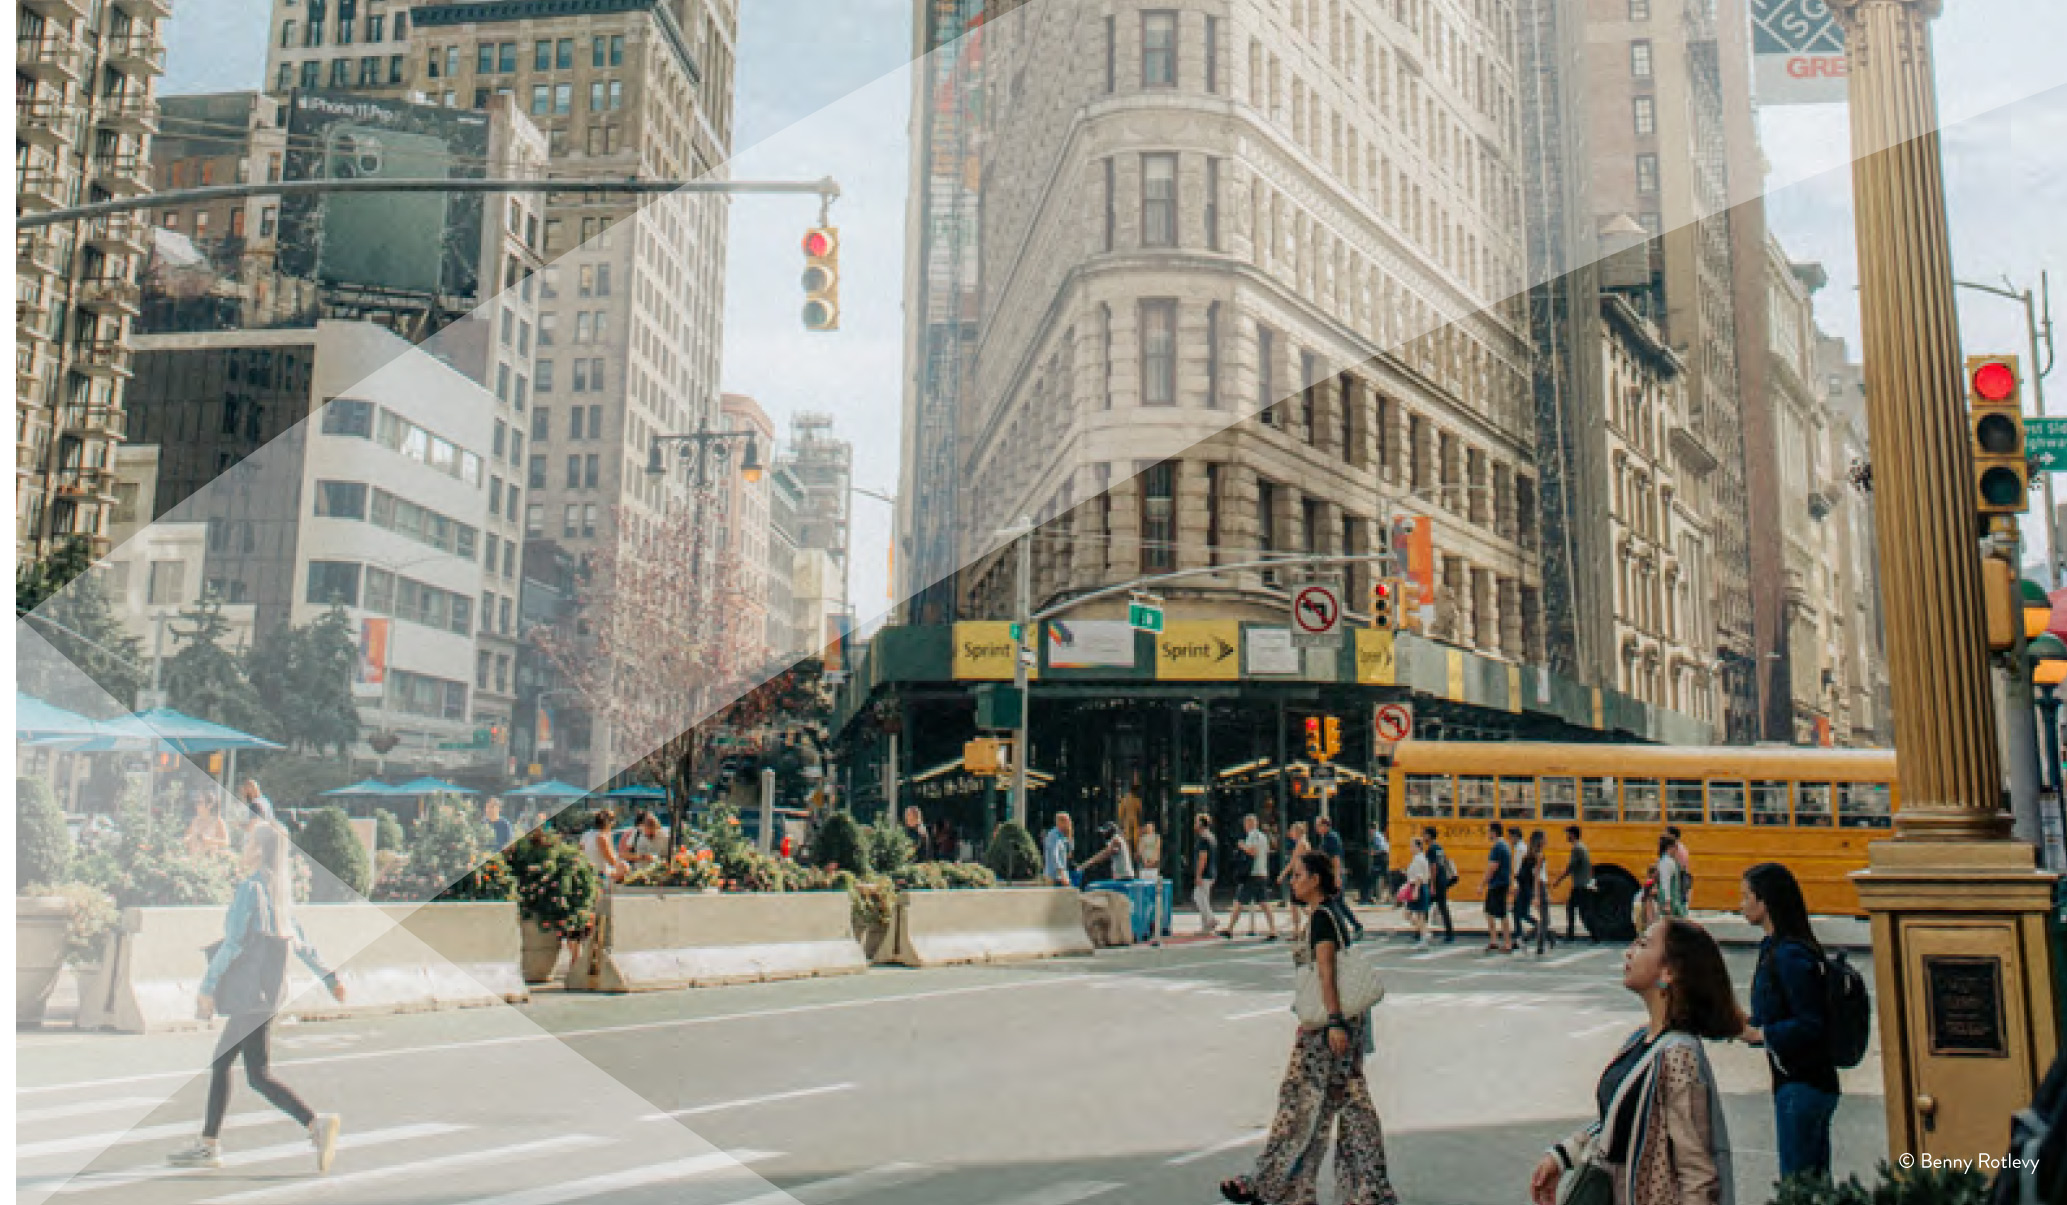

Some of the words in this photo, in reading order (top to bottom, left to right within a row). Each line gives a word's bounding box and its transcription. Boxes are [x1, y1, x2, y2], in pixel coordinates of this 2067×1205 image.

[308, 97, 354, 115] iPhone
[964, 642, 1010, 661] Sprint
[1162, 641, 1211, 661] Sprint
